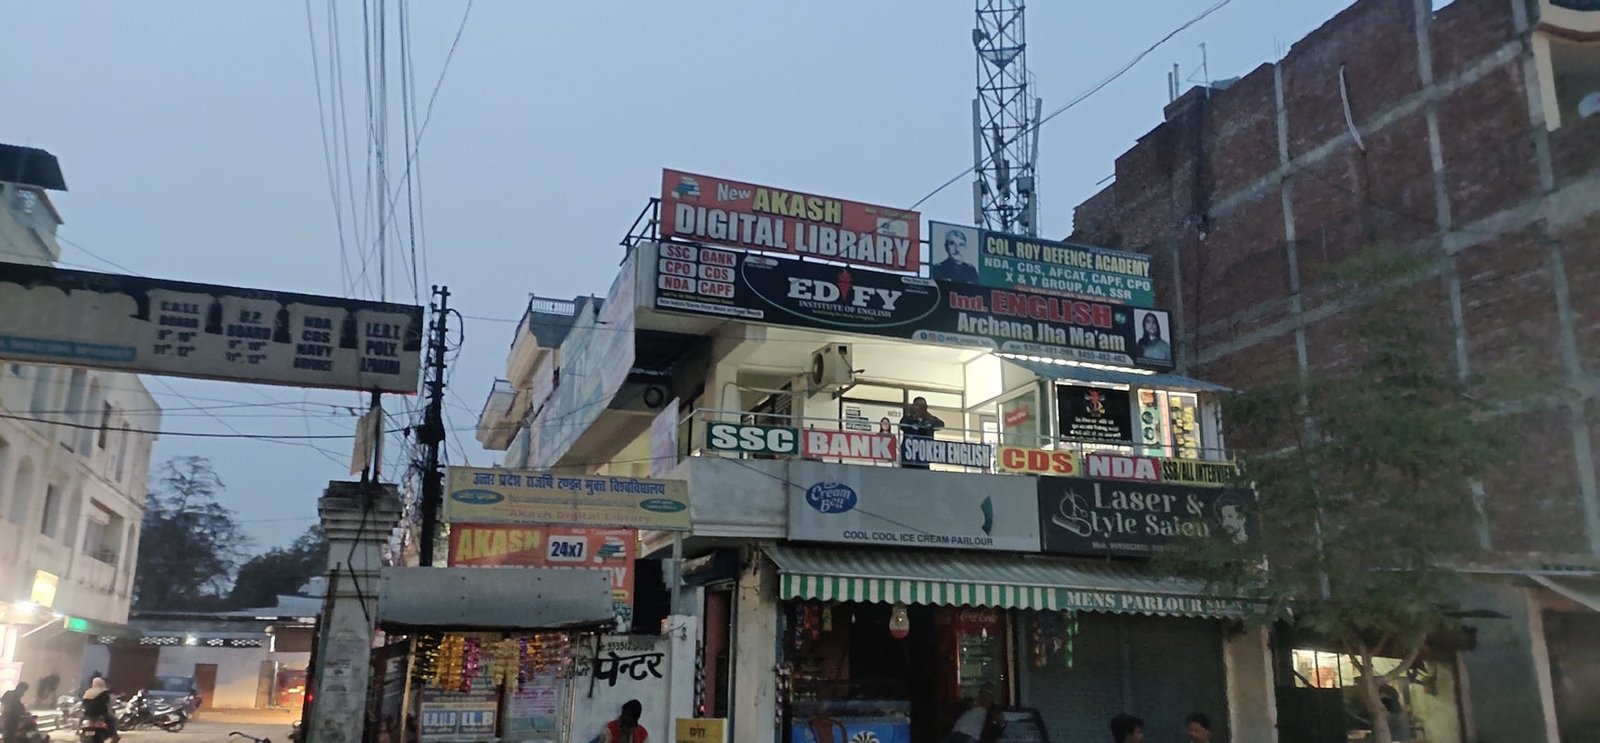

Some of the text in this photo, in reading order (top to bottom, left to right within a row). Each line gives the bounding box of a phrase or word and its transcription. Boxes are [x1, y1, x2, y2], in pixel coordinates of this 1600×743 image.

[717, 182, 751, 202] New
[752, 187, 842, 225] AKASH
[674, 202, 912, 268] DIGITAL LIBRARY
[666, 245, 691, 260] SSC
[701, 250, 734, 267] BANK
[986, 236, 1014, 258] COL.
[1016, 241, 1041, 262] ROY
[1043, 246, 1093, 269] DEFENCE
[1094, 252, 1150, 278] ACADEMY
[665, 262, 691, 276] CPO
[704, 267, 729, 281] CDS
[984, 256, 1150, 292] NDA, CDS, AFCAT, CAPF, CPO
[663, 275, 690, 292] NDA
[700, 282, 732, 297] CAPF
[1006, 272, 1013, 283] X
[1016, 273, 1026, 286] &
[1031, 275, 1038, 287] Y
[1041, 277, 1083, 295] GROUP,
[1086, 284, 1108, 298] AA,
[1109, 287, 1132, 300] SSR
[799, 299, 847, 314] INSTITUTE
[845, 305, 856, 315] OF
[856, 307, 892, 319] ENGLISH
[949, 291, 988, 313] Ind.
[991, 290, 1113, 330] ENGLISH
[227, 324, 272, 340] BOARD
[304, 316, 332, 331] NDA
[957, 312, 1126, 351] Archana Jha Ma'am
[302, 330, 331, 343] CDS
[296, 343, 334, 357] NAVY
[711, 425, 795, 453] SSC
[808, 431, 892, 460] BANK
[904, 437, 991, 470] SPOKEN ENGLISH
[1002, 448, 1074, 474] CDS
[1088, 455, 1157, 481] NDA
[811, 484, 852, 501] Cream
[1093, 483, 1205, 518] Laser &
[508, 509, 552, 519] Akash
[820, 497, 845, 512] Bell
[1145, 514, 1210, 538] Salon
[454, 529, 542, 562] AKASH
[550, 540, 584, 558] 24x7
[843, 530, 993, 547] COOL COOL ICE CREAM PARLOUR
[1067, 591, 1116, 609] MENS
[1121, 594, 1203, 613] PARLOUR
[594, 651, 665, 687] पेन्टर
